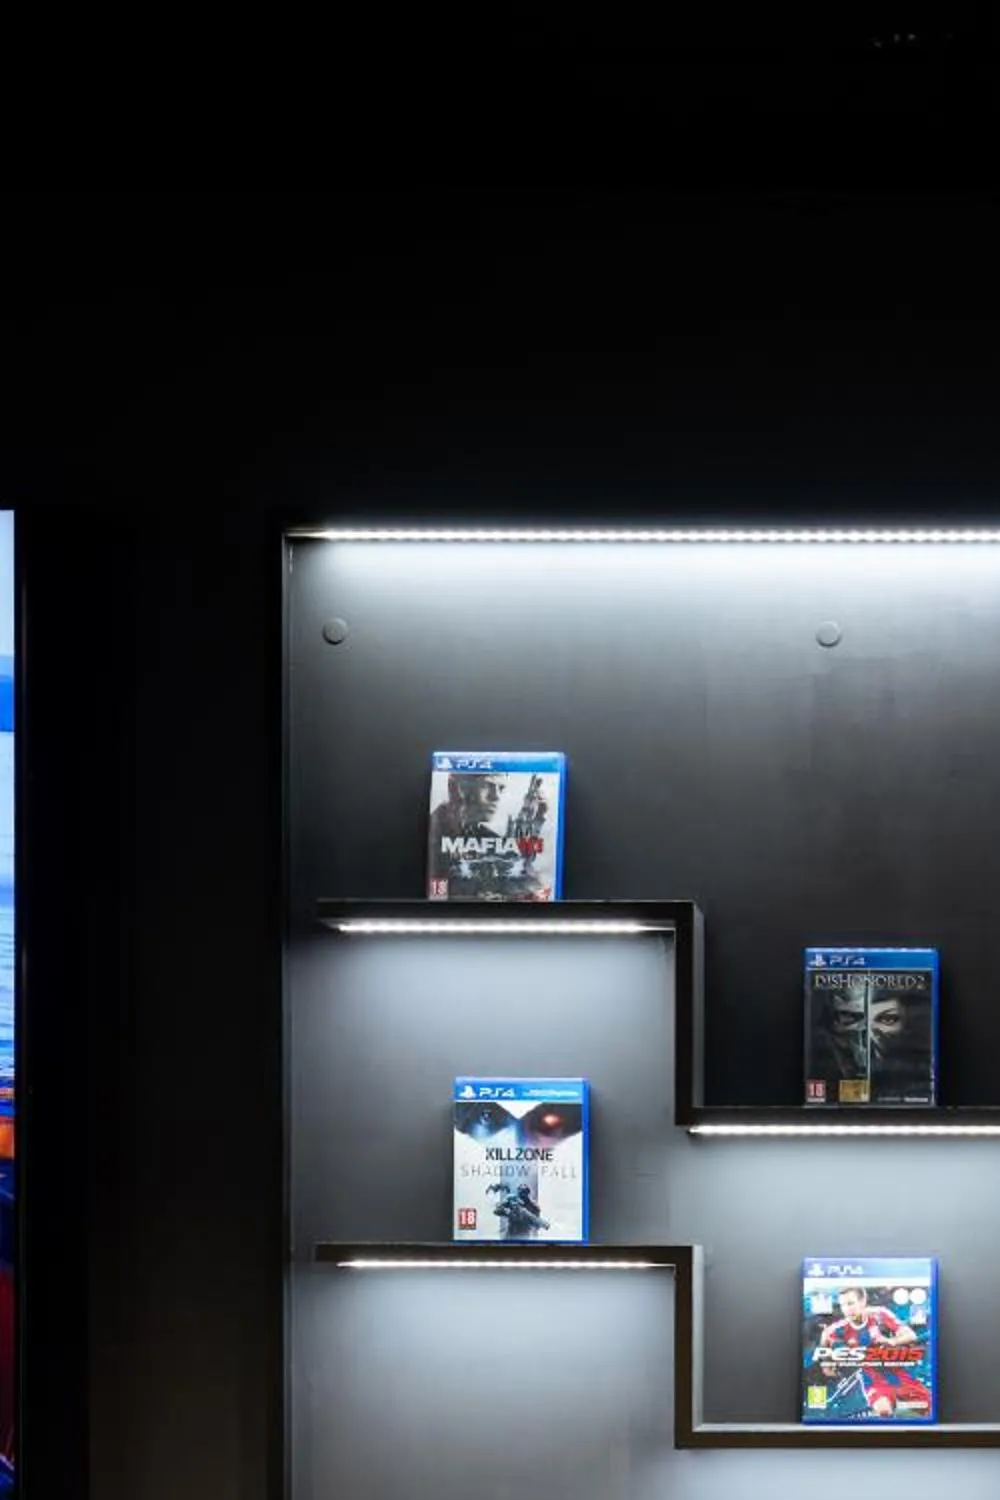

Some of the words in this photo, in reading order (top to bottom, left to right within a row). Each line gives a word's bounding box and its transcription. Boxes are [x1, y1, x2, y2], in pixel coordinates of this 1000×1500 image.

[441, 836, 518, 853] MAFIA
[829, 955, 865, 966] PS4
[479, 1087, 515, 1097] PS4
[485, 1147, 555, 1161] KILLZONE
[460, 1164, 531, 1178] SHADOW
[540, 1164, 578, 1178] FALL
[460, 1210, 476, 1225] 18
